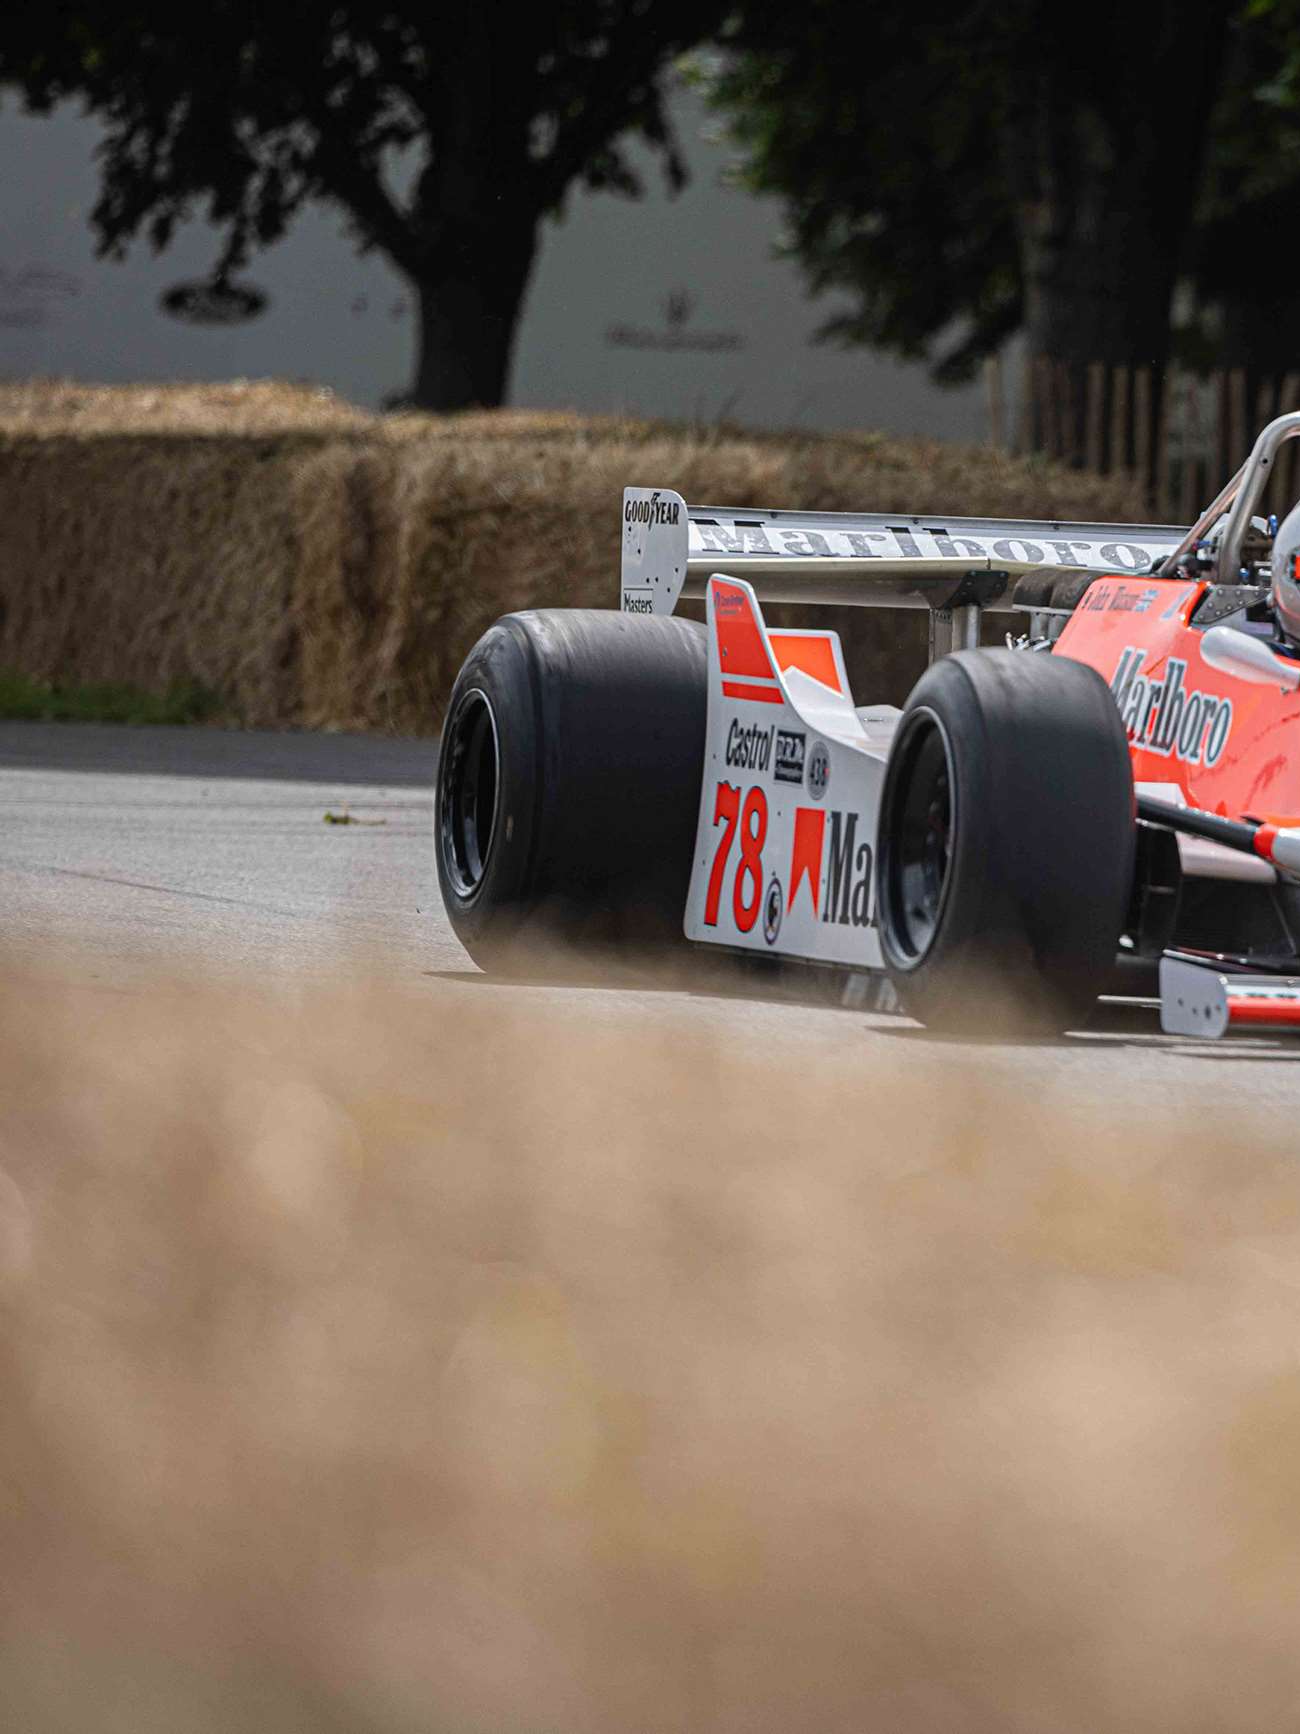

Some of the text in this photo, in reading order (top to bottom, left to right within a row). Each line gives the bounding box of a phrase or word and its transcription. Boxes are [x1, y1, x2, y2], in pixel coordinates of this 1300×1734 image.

[689, 518, 1152, 570] Marlboro
[624, 593, 653, 614] Masters
[726, 717, 775, 771] Castrol
[704, 780, 768, 934] 78
[823, 811, 878, 928] Ma
